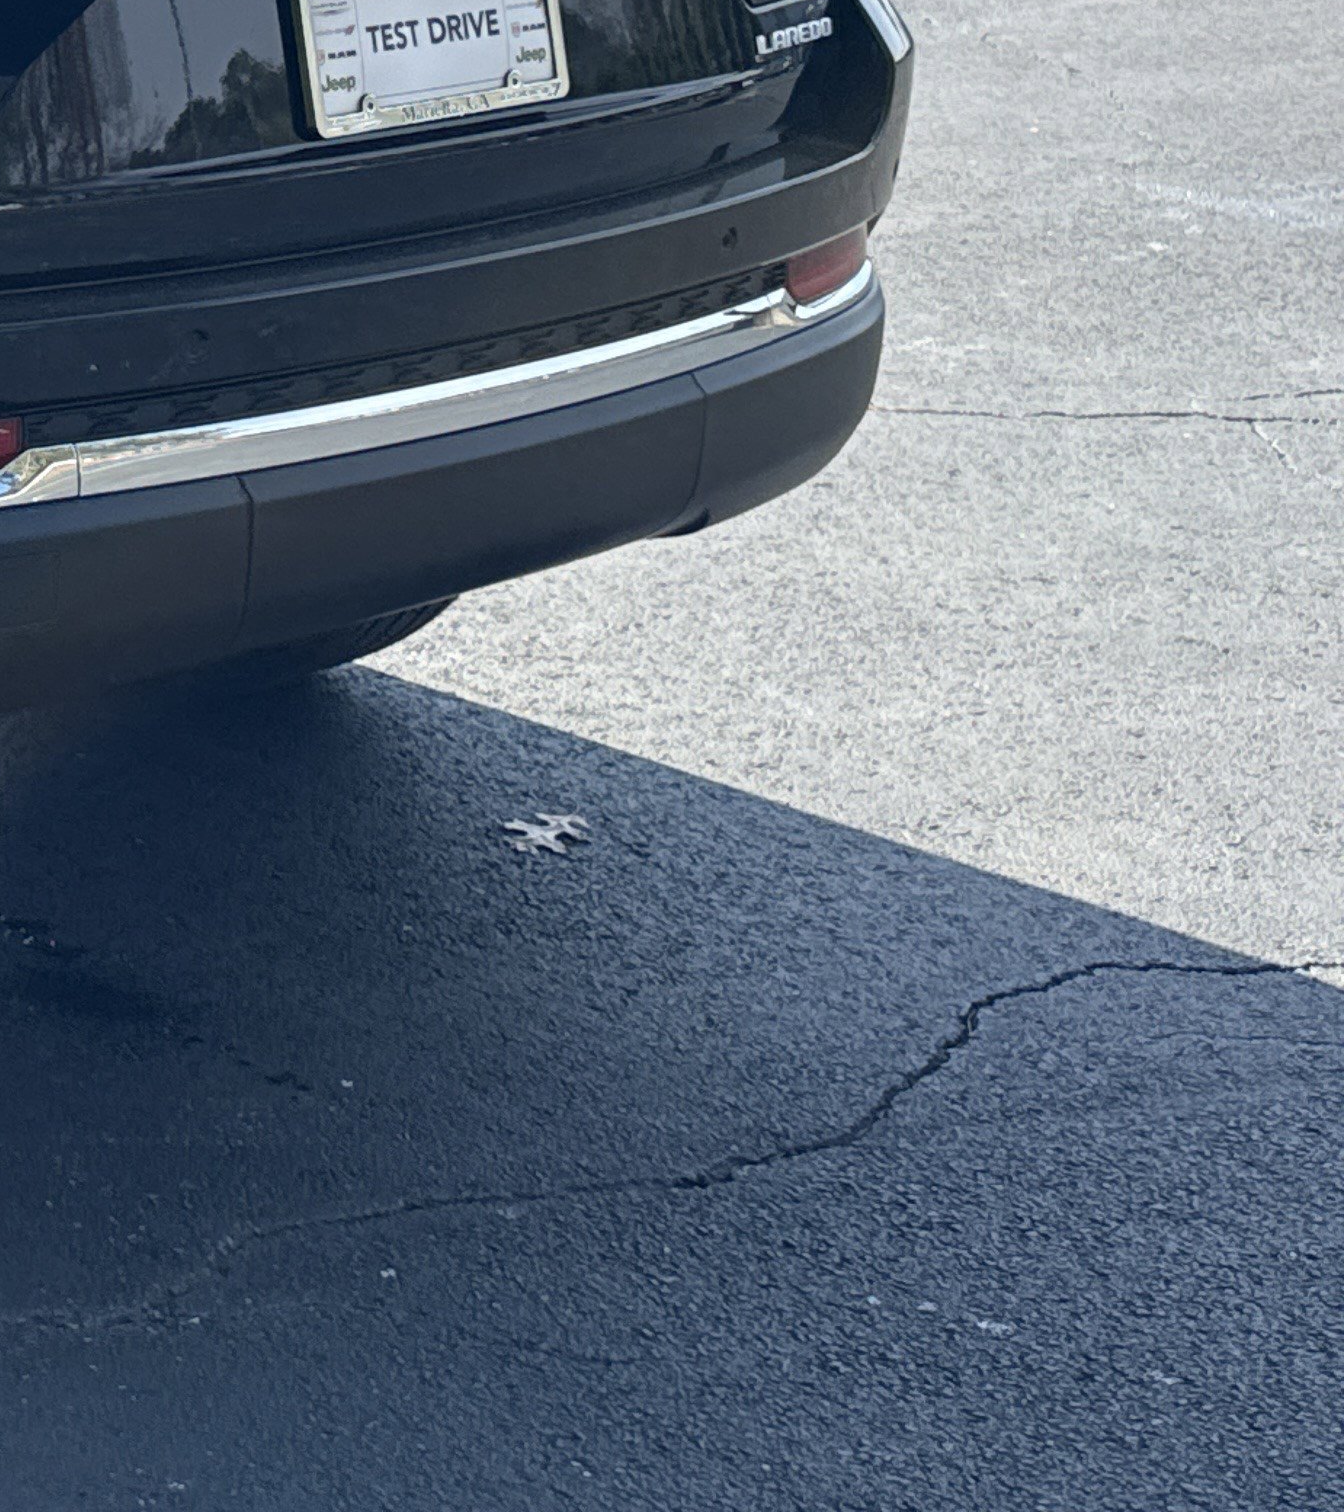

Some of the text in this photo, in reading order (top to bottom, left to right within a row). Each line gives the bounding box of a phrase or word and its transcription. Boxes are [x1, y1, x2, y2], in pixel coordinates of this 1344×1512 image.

[365, 9, 501, 53] TEST DRIVE
[755, 16, 833, 55] LAREDO
[515, 45, 547, 64] Jeep
[321, 74, 357, 93] Jeep
